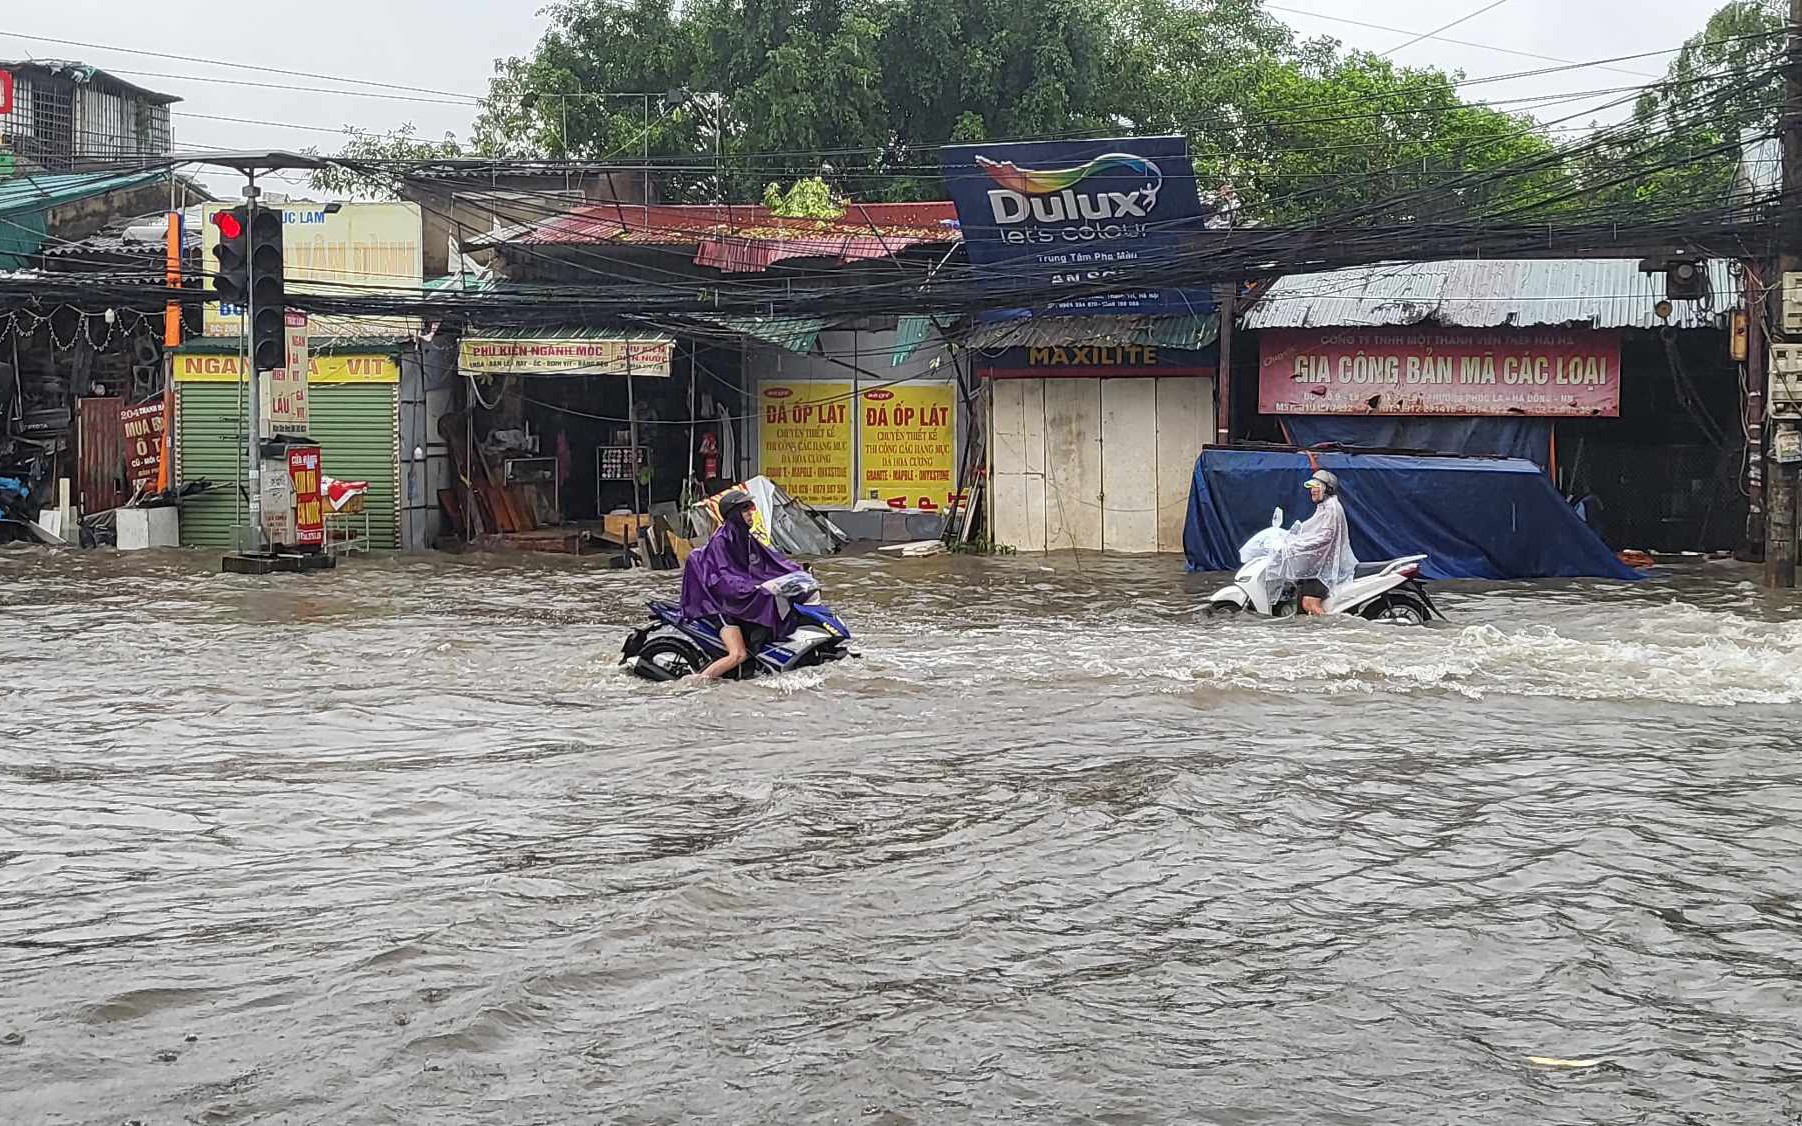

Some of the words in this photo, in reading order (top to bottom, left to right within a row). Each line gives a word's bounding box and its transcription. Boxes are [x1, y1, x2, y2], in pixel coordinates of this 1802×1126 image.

[987, 189, 1146, 224] Dulux
[1062, 222, 1149, 241] colour
[1037, 253, 1067, 264] Trung
[1094, 251, 1114, 261] Pha
[1030, 347, 1158, 365] MAXILITE
[347, 357, 386, 379] VỊT
[1294, 356, 1331, 384] GIA
[1338, 350, 1399, 385] CÔNG
[1406, 347, 1453, 385] BẢN
[1459, 352, 1496, 385] MÃ
[1503, 352, 1549, 385] CÁC
[1556, 356, 1607, 391] LOẠI
[120, 409, 140, 420] 204
[866, 403, 888, 427] ĐÁ
[893, 400, 914, 427] ỐP
[920, 403, 948, 427] LÁT
[124, 418, 150, 438] MUA
[136, 437, 148, 456] Ô
